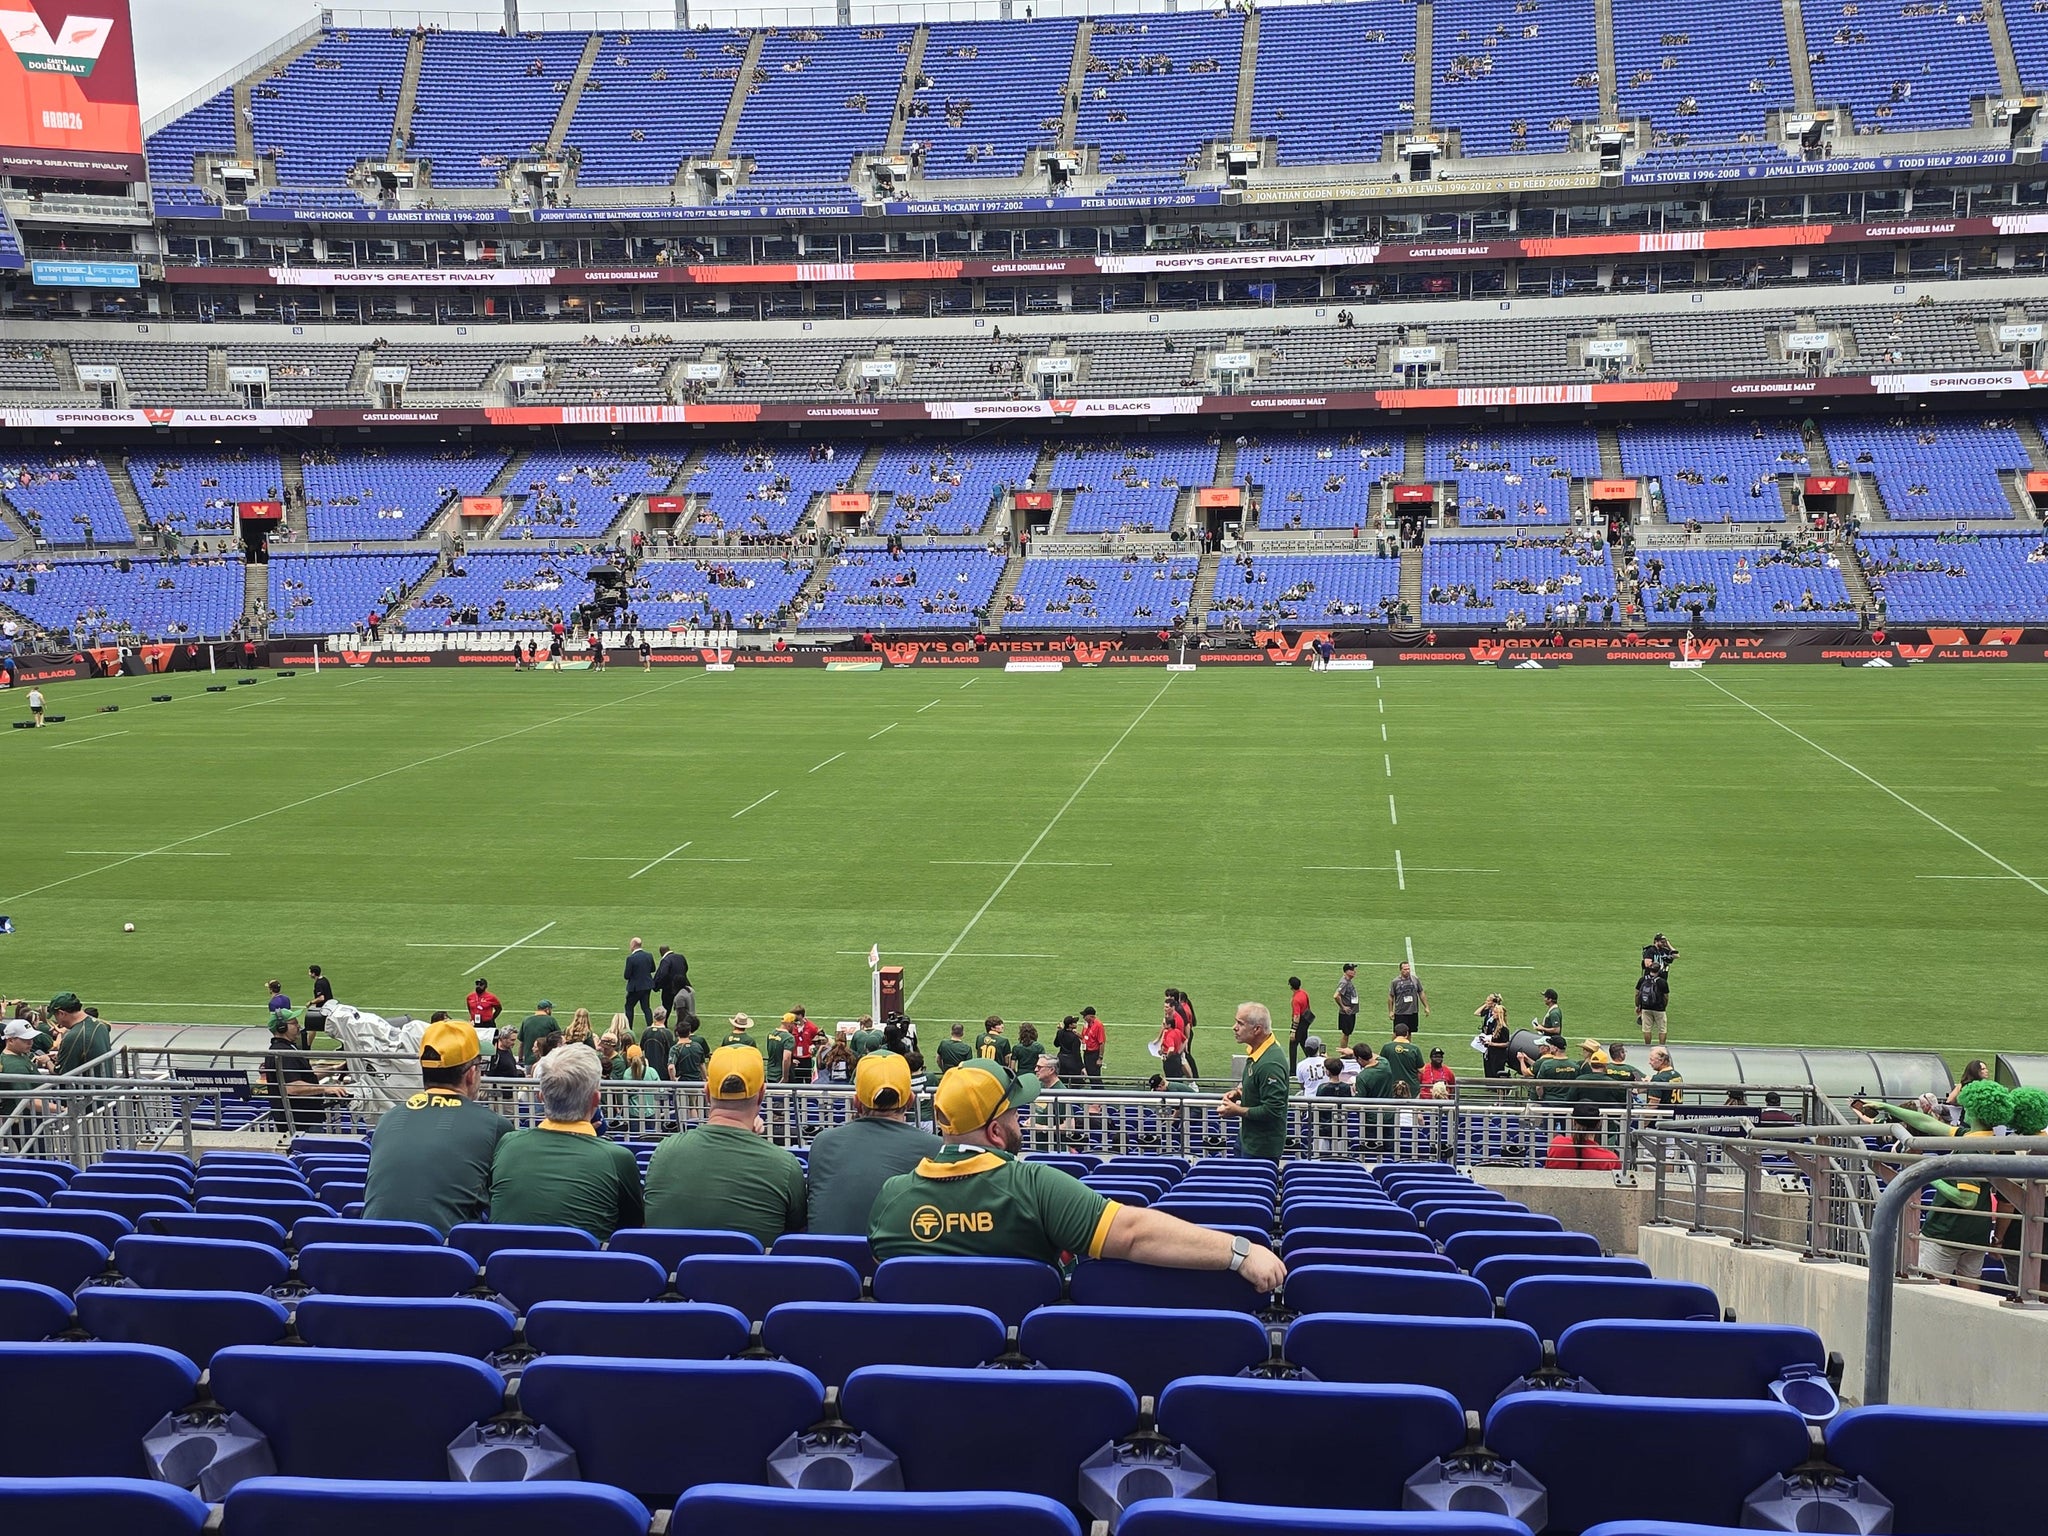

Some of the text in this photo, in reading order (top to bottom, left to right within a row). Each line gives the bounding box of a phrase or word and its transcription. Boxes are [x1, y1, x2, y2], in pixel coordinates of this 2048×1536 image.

[29, 61, 86, 73] DOUBLE MALT
[3, 157, 129, 170] RUGBY'S GREATEST RIVALRY
[1898, 154, 2006, 168] TODD HEAP 2001-2010
[1763, 161, 1876, 177] JAMAL LEWIS 2000-2006
[1631, 169, 1740, 182] MATT STOVER 1996-2008
[1416, 184, 1443, 192] LEWIS
[1446, 182, 1492, 191] 1996-2012
[1509, 177, 1596, 189] ED REED 2002-2012
[1256, 188, 1381, 201] JONATHAN OGDEN 1996-2007
[1081, 196, 1196, 207] PETER BOULWARE 1997-2005
[775, 207, 850, 215] ARTHUR B. MODELL
[907, 202, 1024, 213] MICHAEL McCRARY 1997-2002
[294, 211, 354, 219] RING HONOR
[387, 212, 423, 220] EARNEST
[453, 213, 494, 221] 1996-2003
[540, 213, 564, 221] JOHNNY
[1866, 224, 1956, 236] CASTLE DOUBLE MALT
[1639, 232, 1705, 252] BALTIMORE
[1409, 249, 1436, 257] CASTLE
[1437, 248, 1467, 256] DOUBLE
[1206, 256, 1265, 265] GREATEST
[1268, 254, 1316, 262] RIVALRY
[335, 273, 495, 281] RUGBY'S GREATEST RIVALRY
[1794, 383, 1816, 391] MALT
[1930, 377, 2013, 386] SPRINGBOKS
[1108, 403, 1151, 411] BLACKS
[873, 642, 948, 652] RUGBY'S
[952, 642, 1044, 652] GATEST
[1478, 639, 1551, 648] RUGBY'
[1200, 654, 1264, 662] SPRINGBOKS
[20, 669, 76, 681] ALL BLACKS
[980, 1045, 996, 1060] 10
[1671, 1087, 1683, 1104] 50
[430, 1096, 462, 1108] FNB
[946, 1211, 993, 1233] FNB
